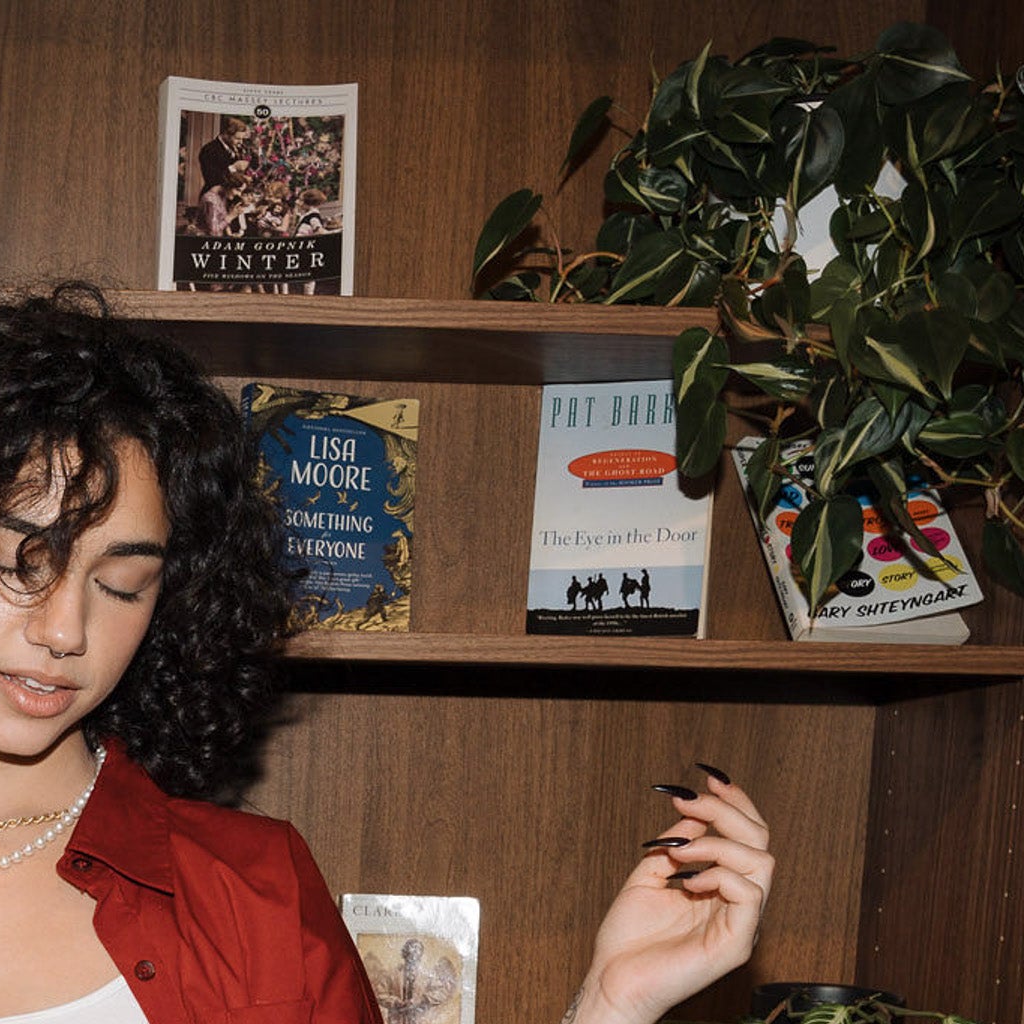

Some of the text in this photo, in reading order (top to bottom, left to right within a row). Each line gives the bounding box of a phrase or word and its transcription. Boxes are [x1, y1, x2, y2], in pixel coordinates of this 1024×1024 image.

[201, 240, 317, 250] ADAM GOPNIK
[191, 252, 325, 271] WINTER
[551, 393, 674, 428] PAT BARK
[310, 434, 356, 463] LISA
[290, 460, 372, 492] MOORE
[285, 508, 373, 534] SOMETHING
[287, 536, 366, 560] EVERYONE
[540, 527, 698, 551] The Eye in the Door
[850, 578, 872, 588] ORY
[882, 572, 916, 584] STORY
[856, 583, 969, 618] SHTEYNGART
